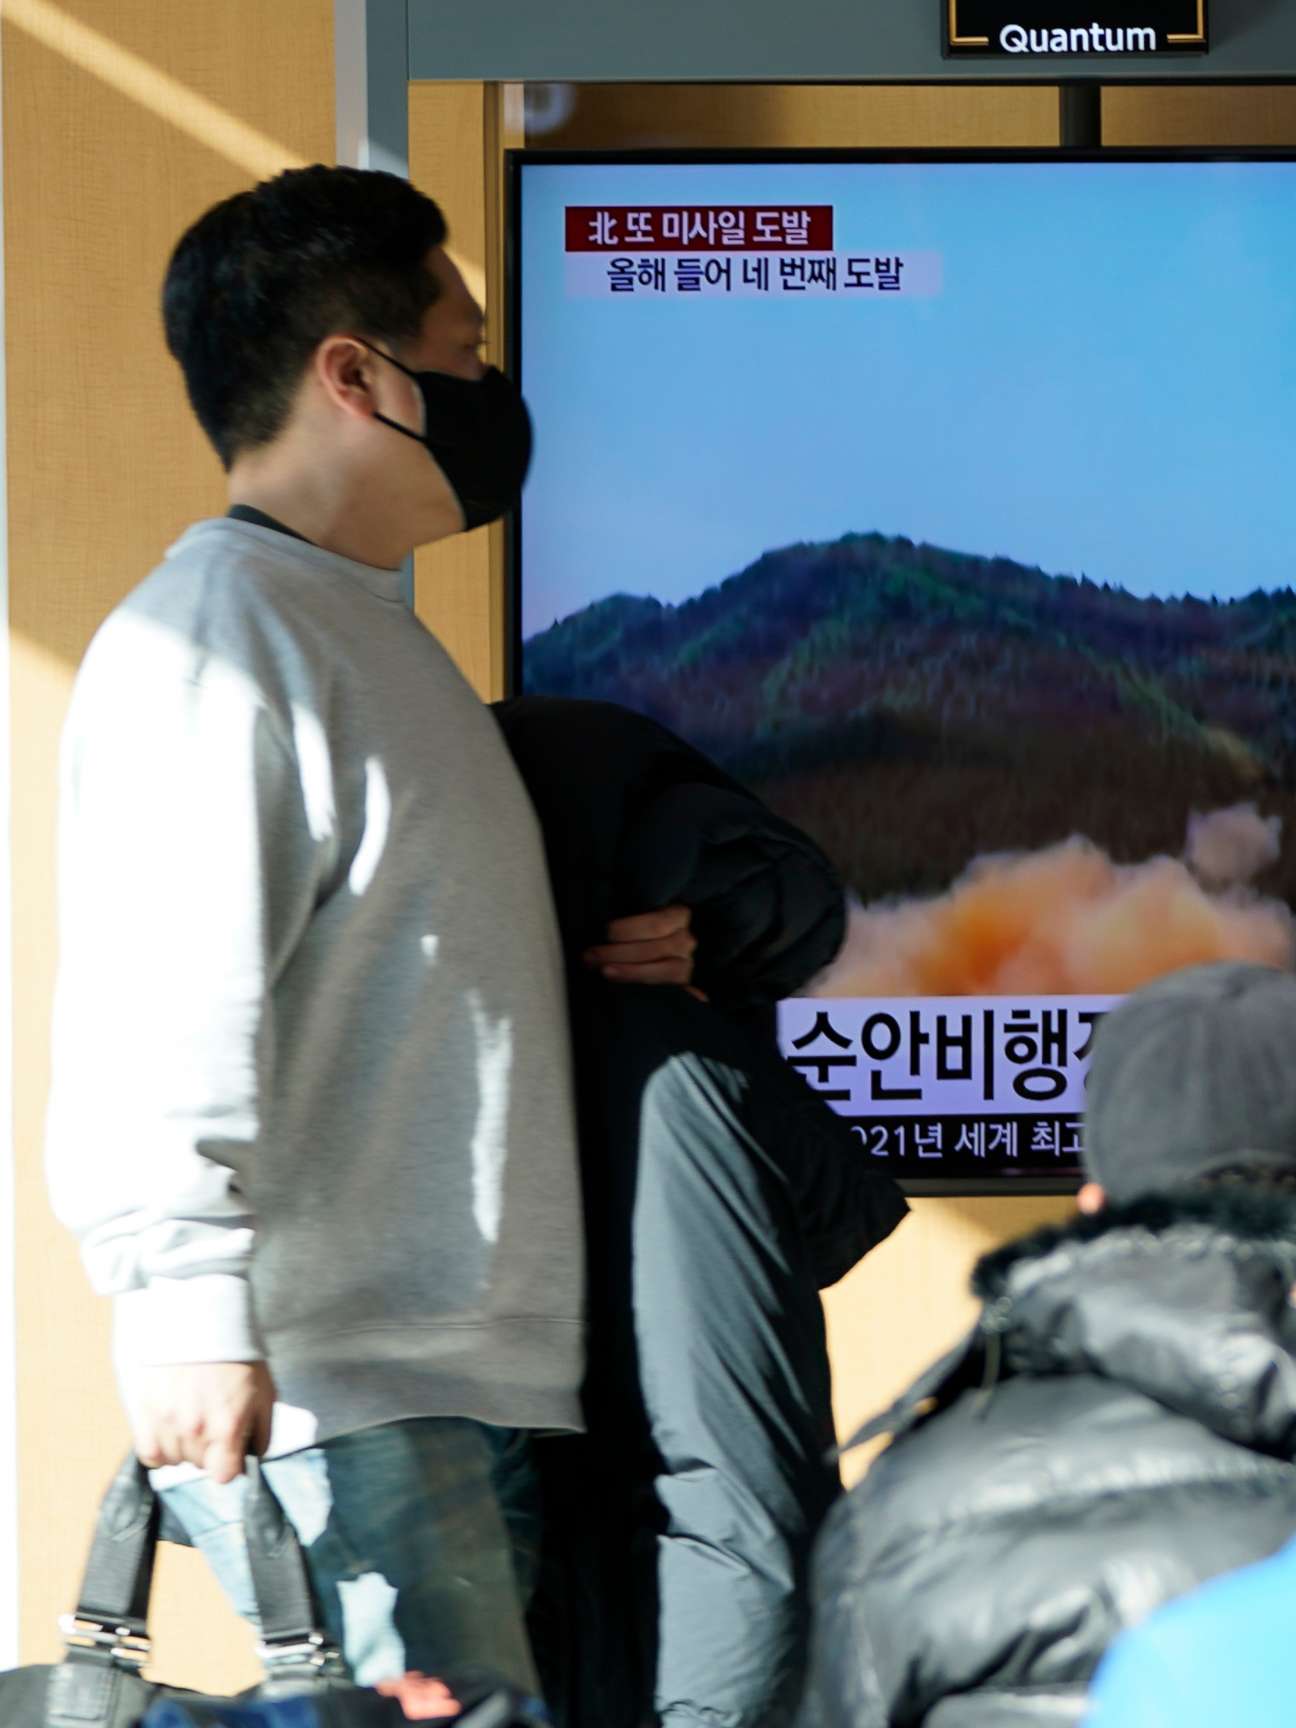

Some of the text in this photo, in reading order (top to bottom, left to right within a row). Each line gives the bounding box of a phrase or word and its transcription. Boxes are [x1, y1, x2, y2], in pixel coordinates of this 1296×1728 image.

[1000, 22, 1156, 53] Quantum
[588, 210, 811, 246] 北 또 미사일 도발
[606, 256, 904, 292] 올해 들어 네 번째 도발
[954, 1121, 1018, 1158] 세계
